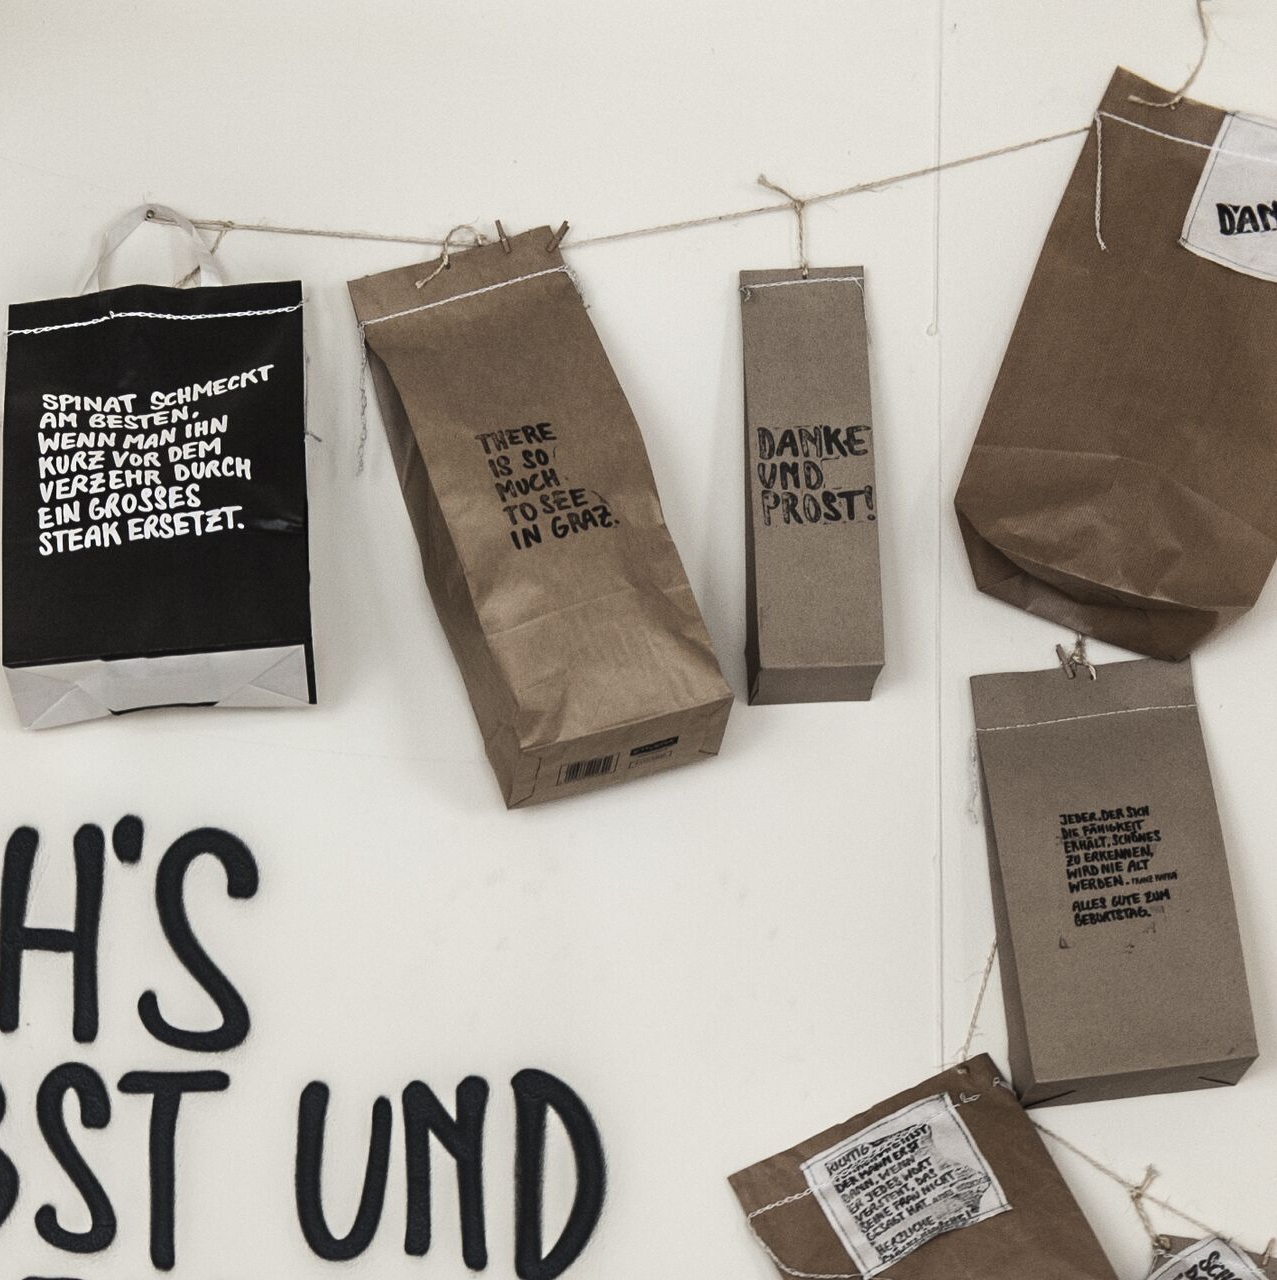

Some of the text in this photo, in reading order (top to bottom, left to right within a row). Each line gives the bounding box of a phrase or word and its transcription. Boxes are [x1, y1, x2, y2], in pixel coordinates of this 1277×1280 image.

[42, 364, 274, 413] SPINAT SCHMECKT
[38, 414, 228, 454] WENN MAN IHN
[39, 412, 77, 429] AM
[475, 422, 557, 454] THERE
[756, 425, 871, 460] DANKE
[38, 437, 221, 479] KURZ VOR DEM
[488, 448, 550, 478] IS SO
[39, 456, 252, 503] VERZEHR DURCH
[494, 468, 561, 503] MUCH
[757, 460, 824, 490] UND
[38, 483, 201, 529] EIN GROSSES
[503, 488, 589, 526] TO SEE
[761, 484, 876, 526] PROST!
[38, 505, 245, 556] STEAK ERSETZT.
[510, 524, 542, 550] IN
[1101, 805, 1150, 821] DER SICH
[1061, 827, 1080, 841] DIE
[1066, 854, 1081, 868] ZU
[1066, 859, 1150, 880] WIRD NIE ALT
[1072, 888, 1171, 912] ALLES GUTE ZUM
[835, 1173, 861, 1193] DER
[864, 1178, 902, 1202] JEDES
